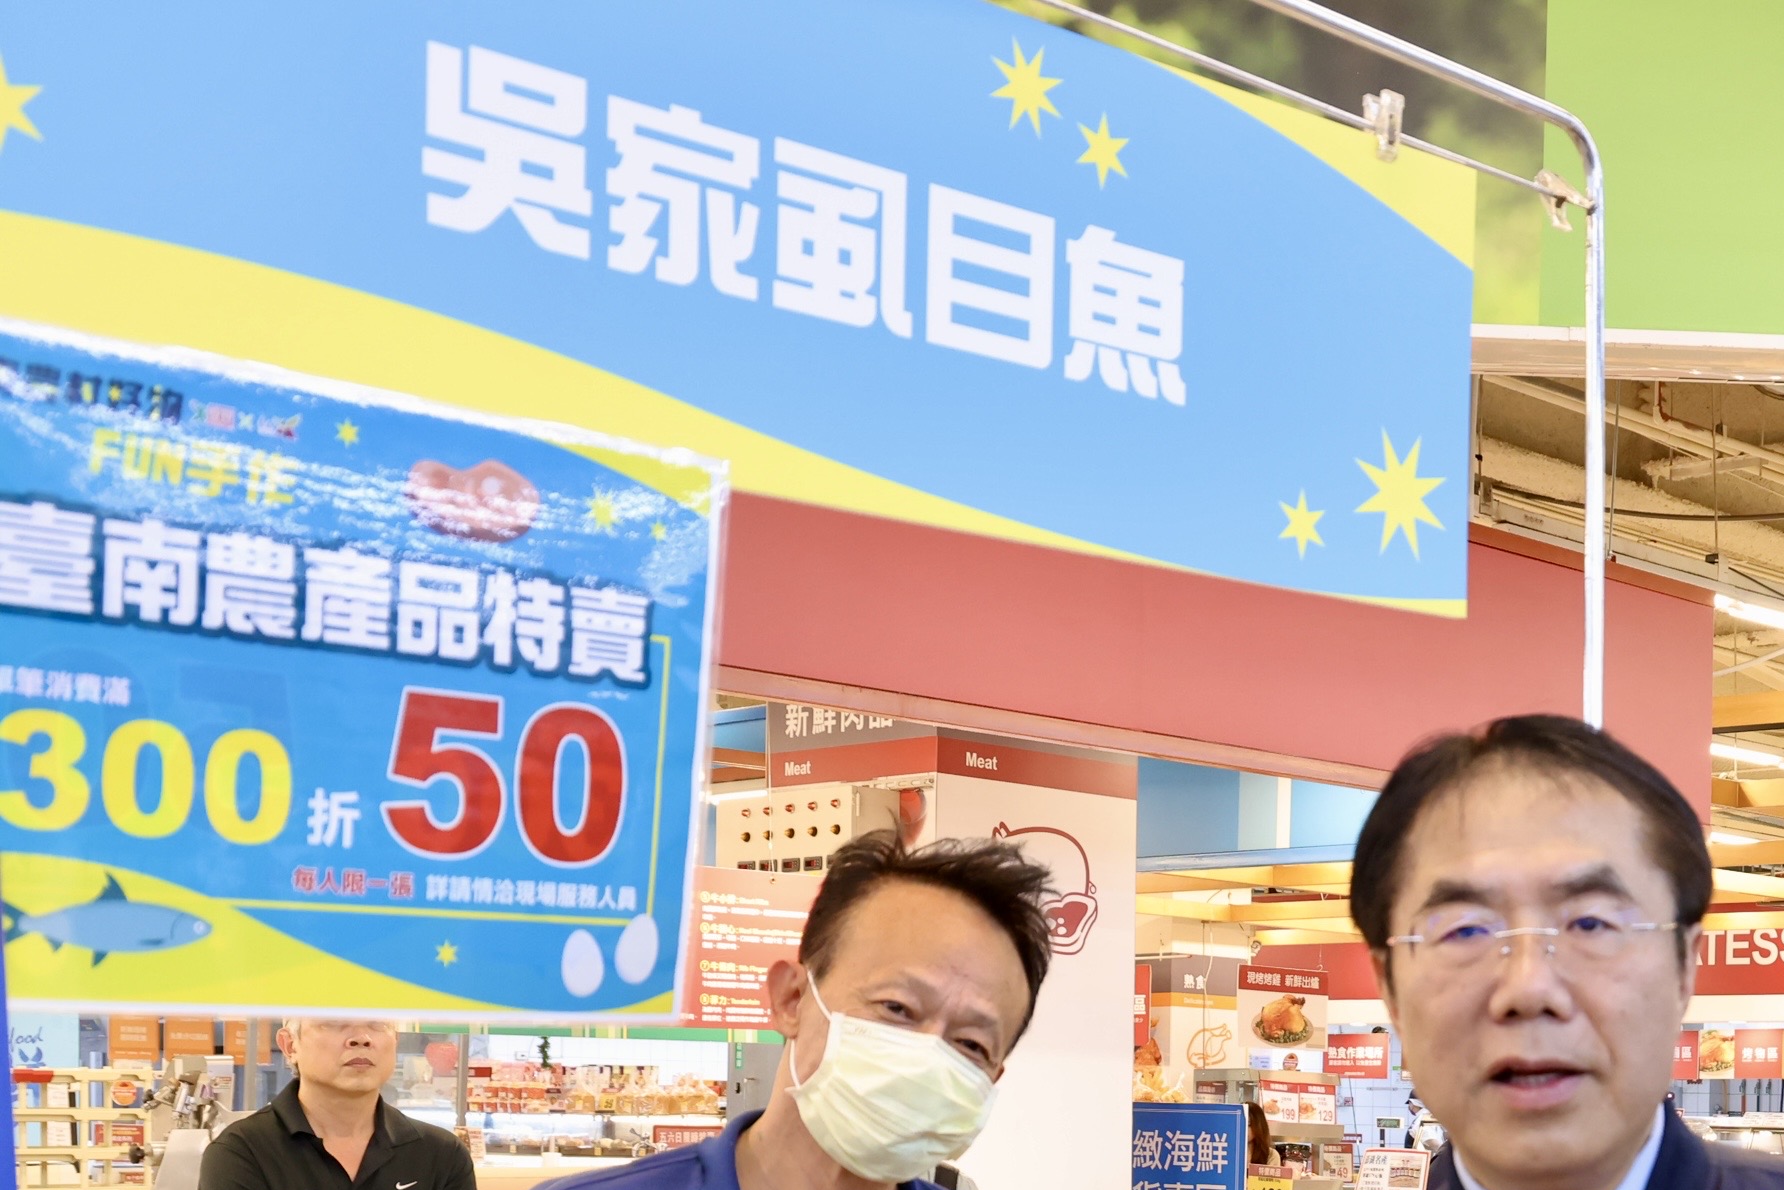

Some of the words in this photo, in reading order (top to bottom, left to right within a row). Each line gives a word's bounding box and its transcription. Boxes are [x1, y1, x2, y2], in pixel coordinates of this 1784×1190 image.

[421, 39, 1186, 406] 吳家虱目魚
[0, 499, 648, 684] 臺南農產品特賣
[784, 761, 811, 777] Meat
[965, 751, 998, 771] Meat
[0, 709, 292, 846] 300
[307, 788, 360, 850] 折
[379, 685, 628, 870] 50
[1281, 1108, 1295, 1120] 199
[1319, 1111, 1333, 1121] 129
[1337, 1167, 1348, 1178] 49
